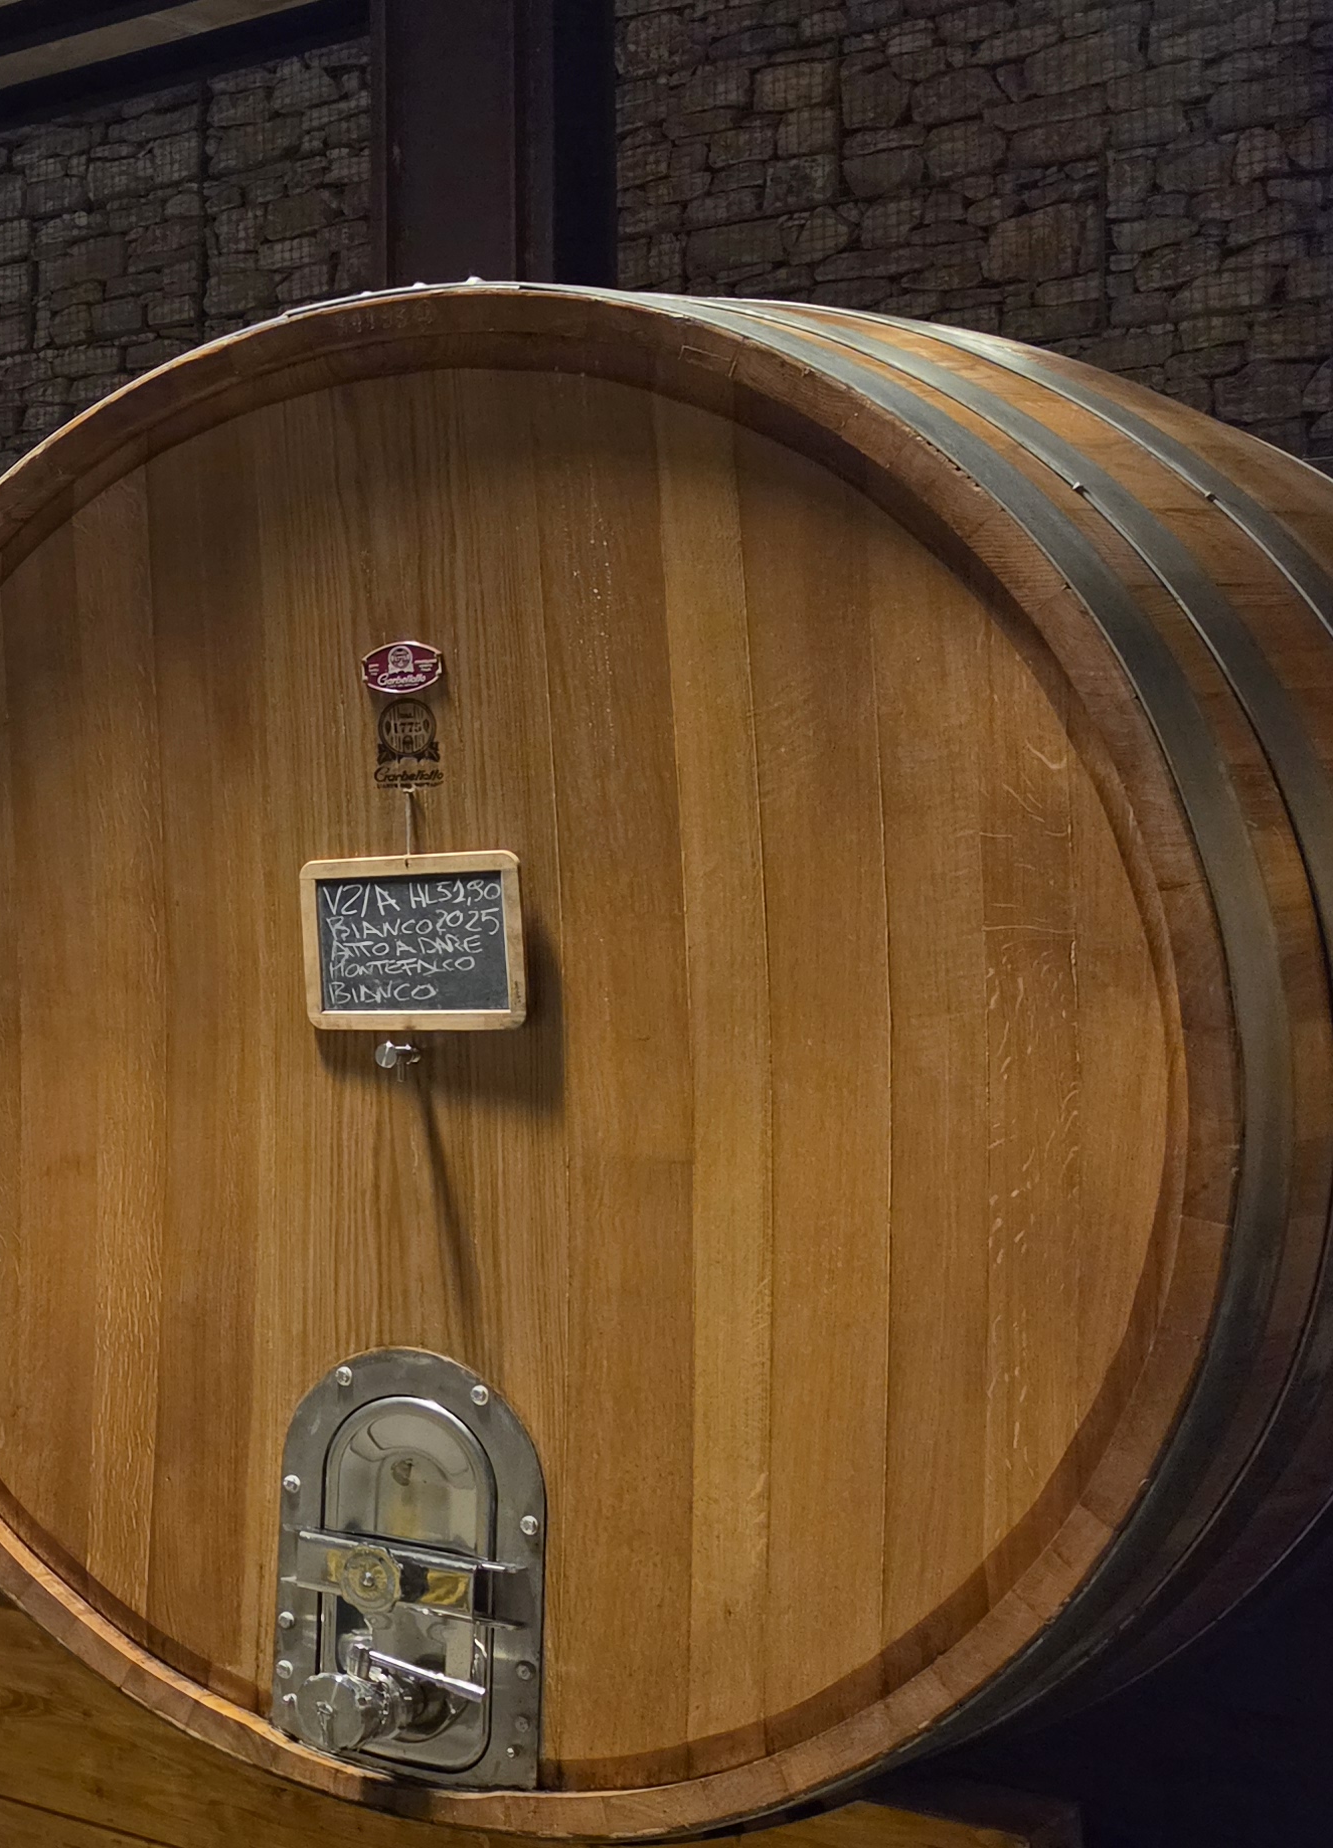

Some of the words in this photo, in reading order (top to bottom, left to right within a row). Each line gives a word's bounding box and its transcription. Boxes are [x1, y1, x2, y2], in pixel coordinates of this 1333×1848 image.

[393, 722, 421, 734] 1775
[326, 916, 432, 941] BIANCO
[436, 907, 500, 935] 2025
[328, 981, 437, 1005] BIANCO
